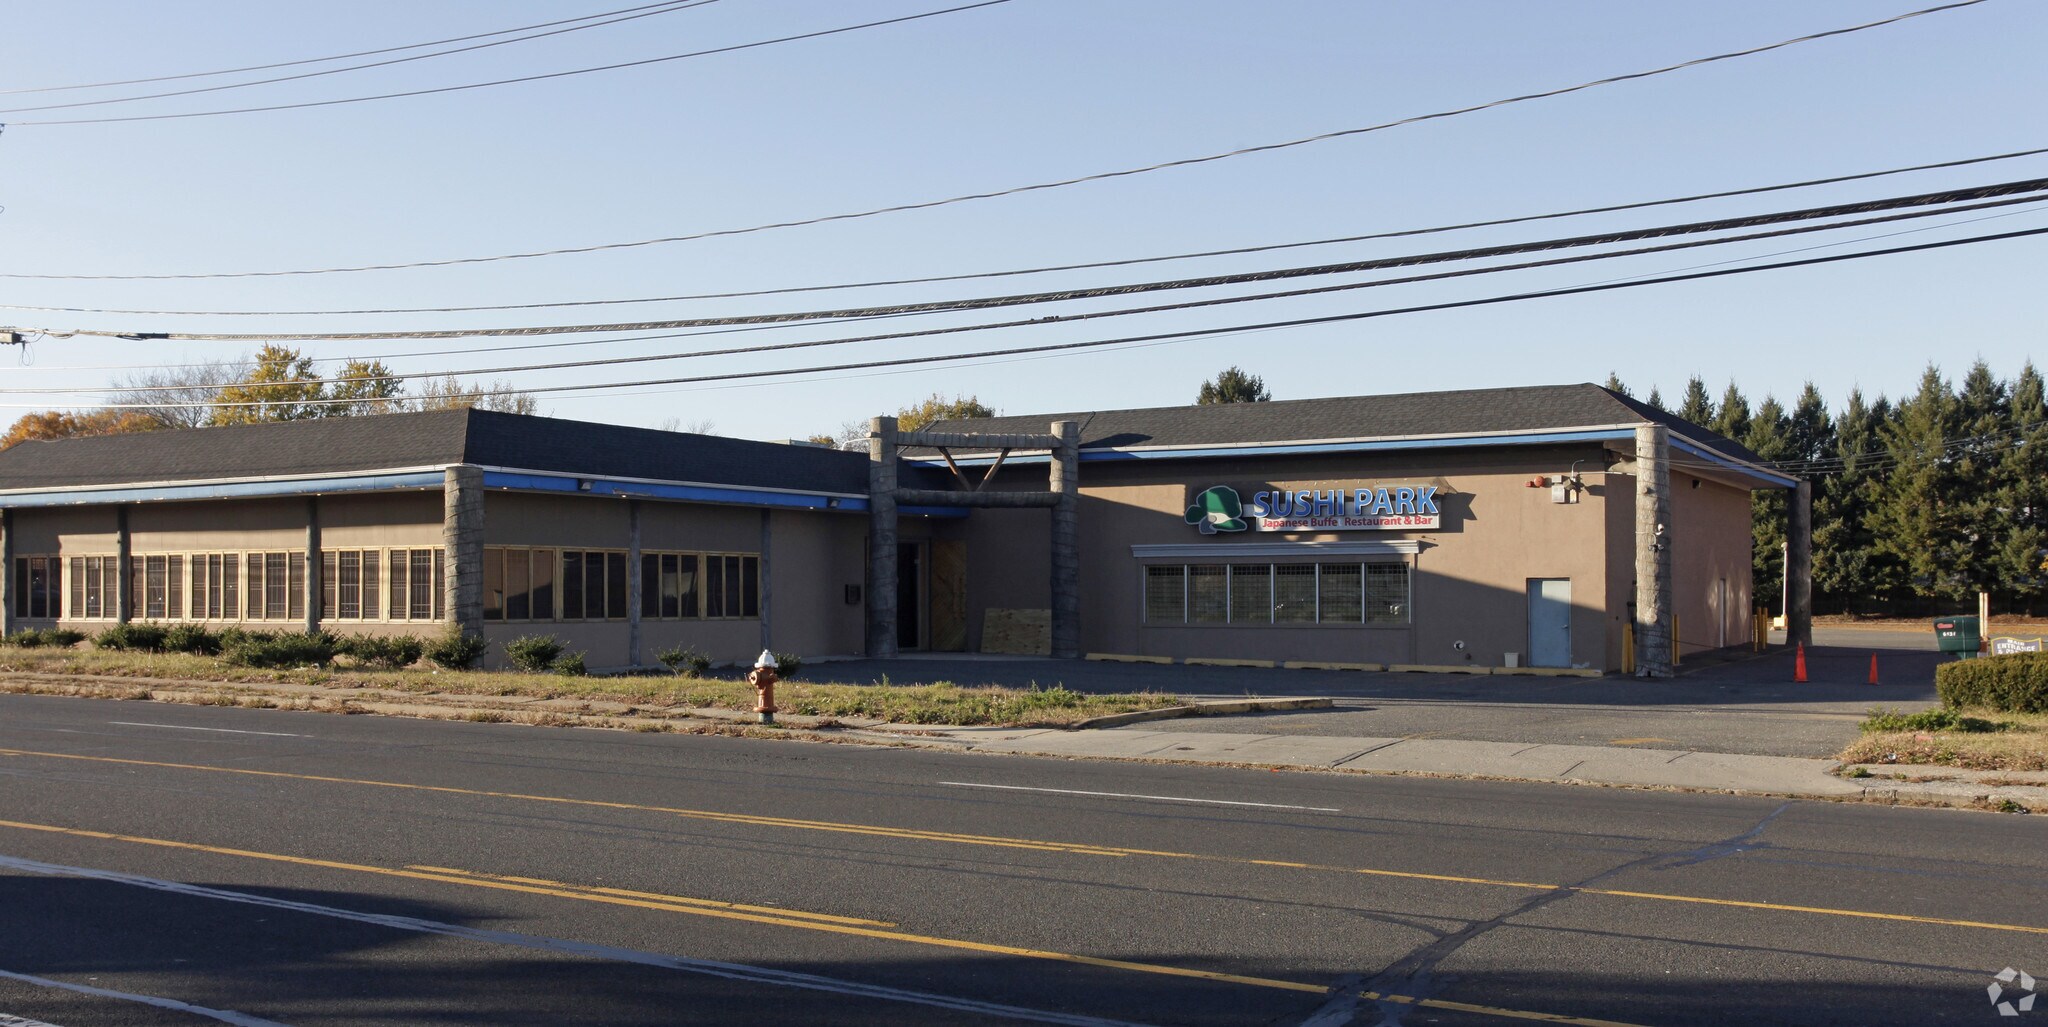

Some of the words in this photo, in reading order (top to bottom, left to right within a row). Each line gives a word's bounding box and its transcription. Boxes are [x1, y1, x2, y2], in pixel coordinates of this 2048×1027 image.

[1253, 489, 1345, 517] SUSHI
[1354, 486, 1439, 515] PARK
[1263, 518, 1309, 529] Japanese
[1344, 516, 1403, 526] Restaurant
[1403, 515, 1412, 525] &
[1414, 515, 1433, 525] Bar
[1997, 643, 2036, 652] ENTRANCE
